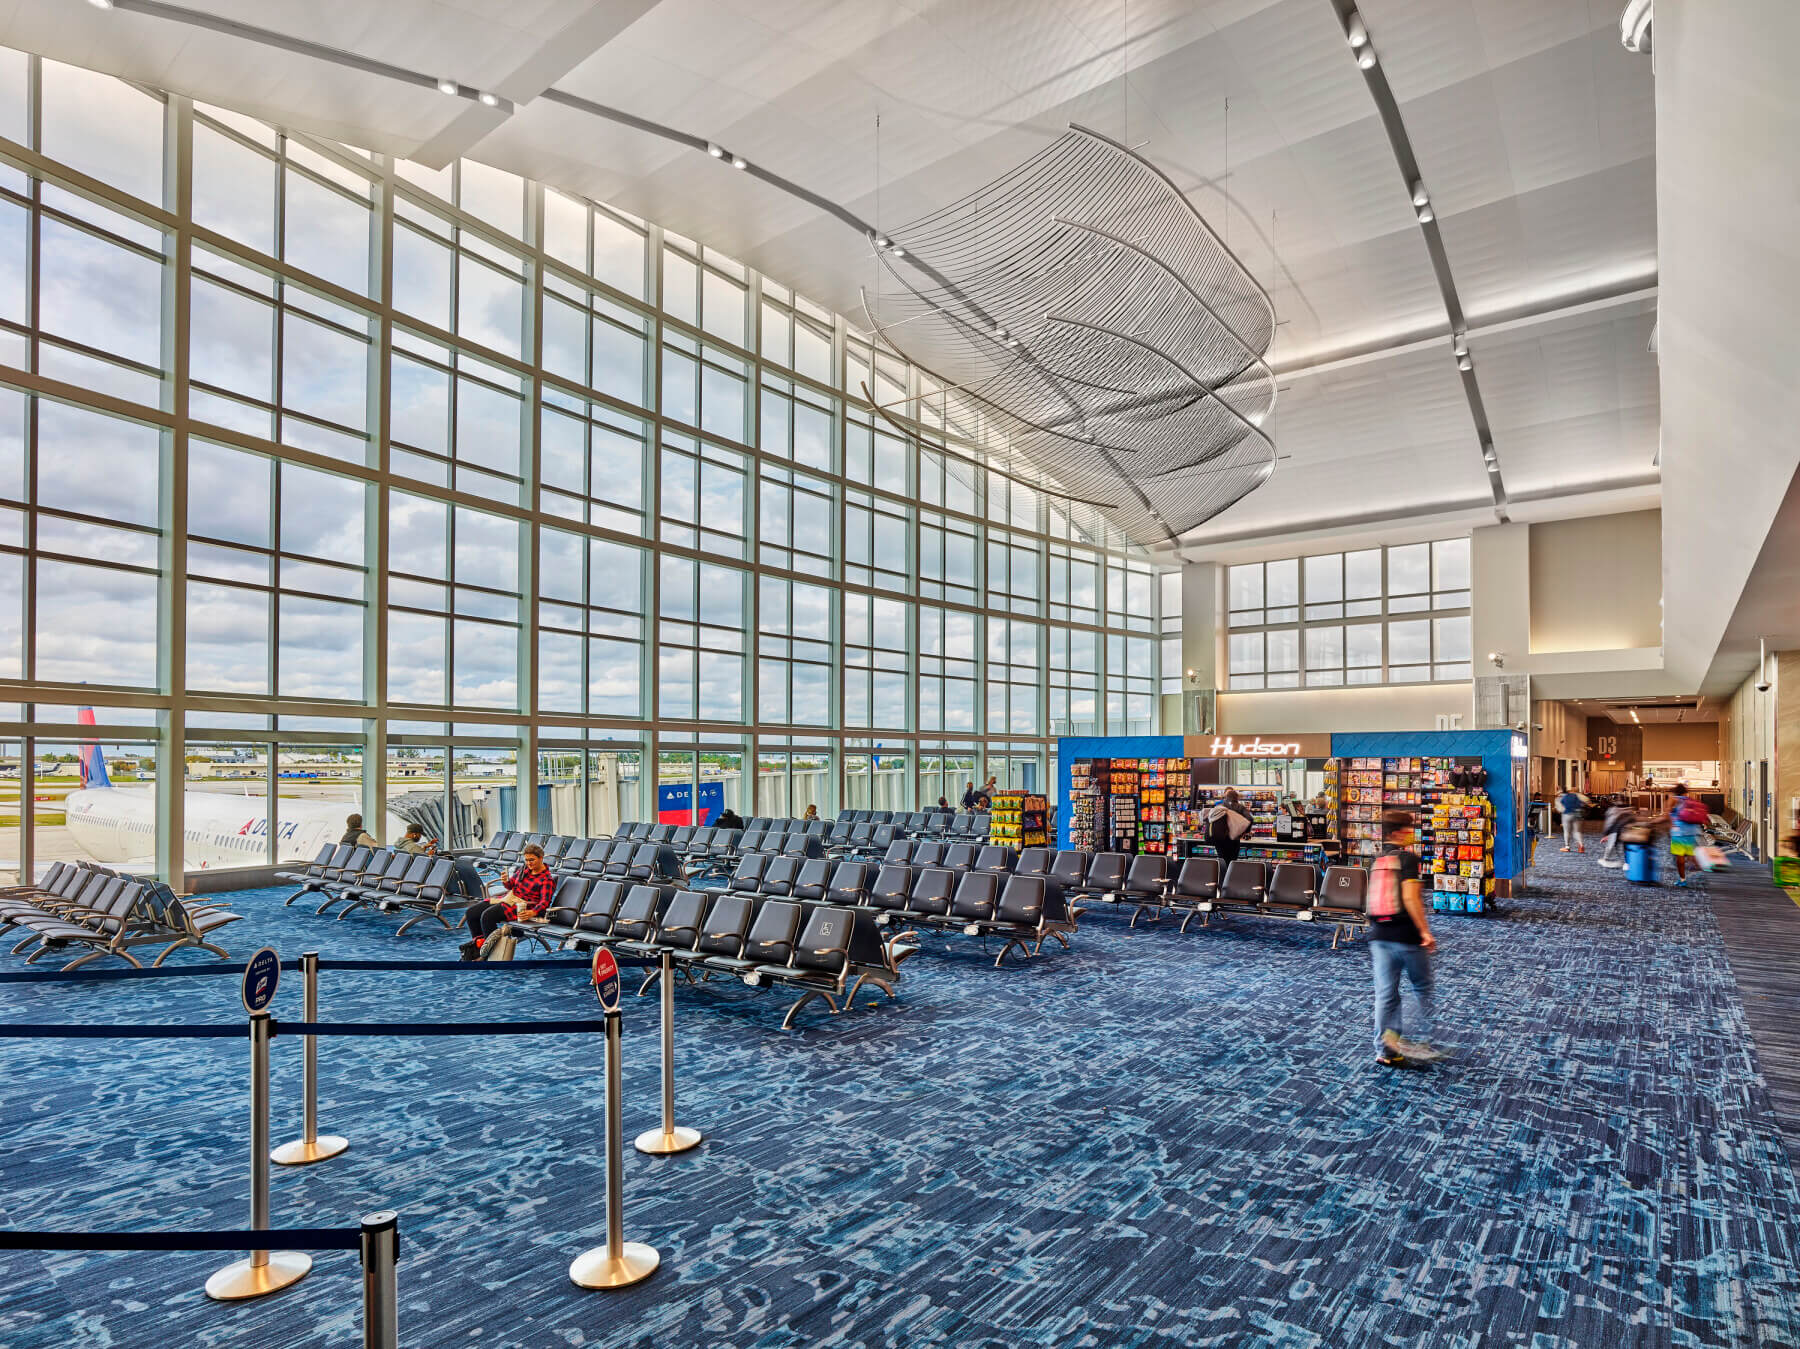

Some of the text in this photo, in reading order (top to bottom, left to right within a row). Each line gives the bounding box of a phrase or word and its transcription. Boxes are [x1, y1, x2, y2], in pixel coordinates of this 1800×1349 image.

[1210, 737, 1300, 755] Hudson
[1598, 736, 1617, 755] D3
[676, 790, 708, 799] DEA
[251, 818, 299, 840] DETA
[257, 957, 273, 967] DELTA
